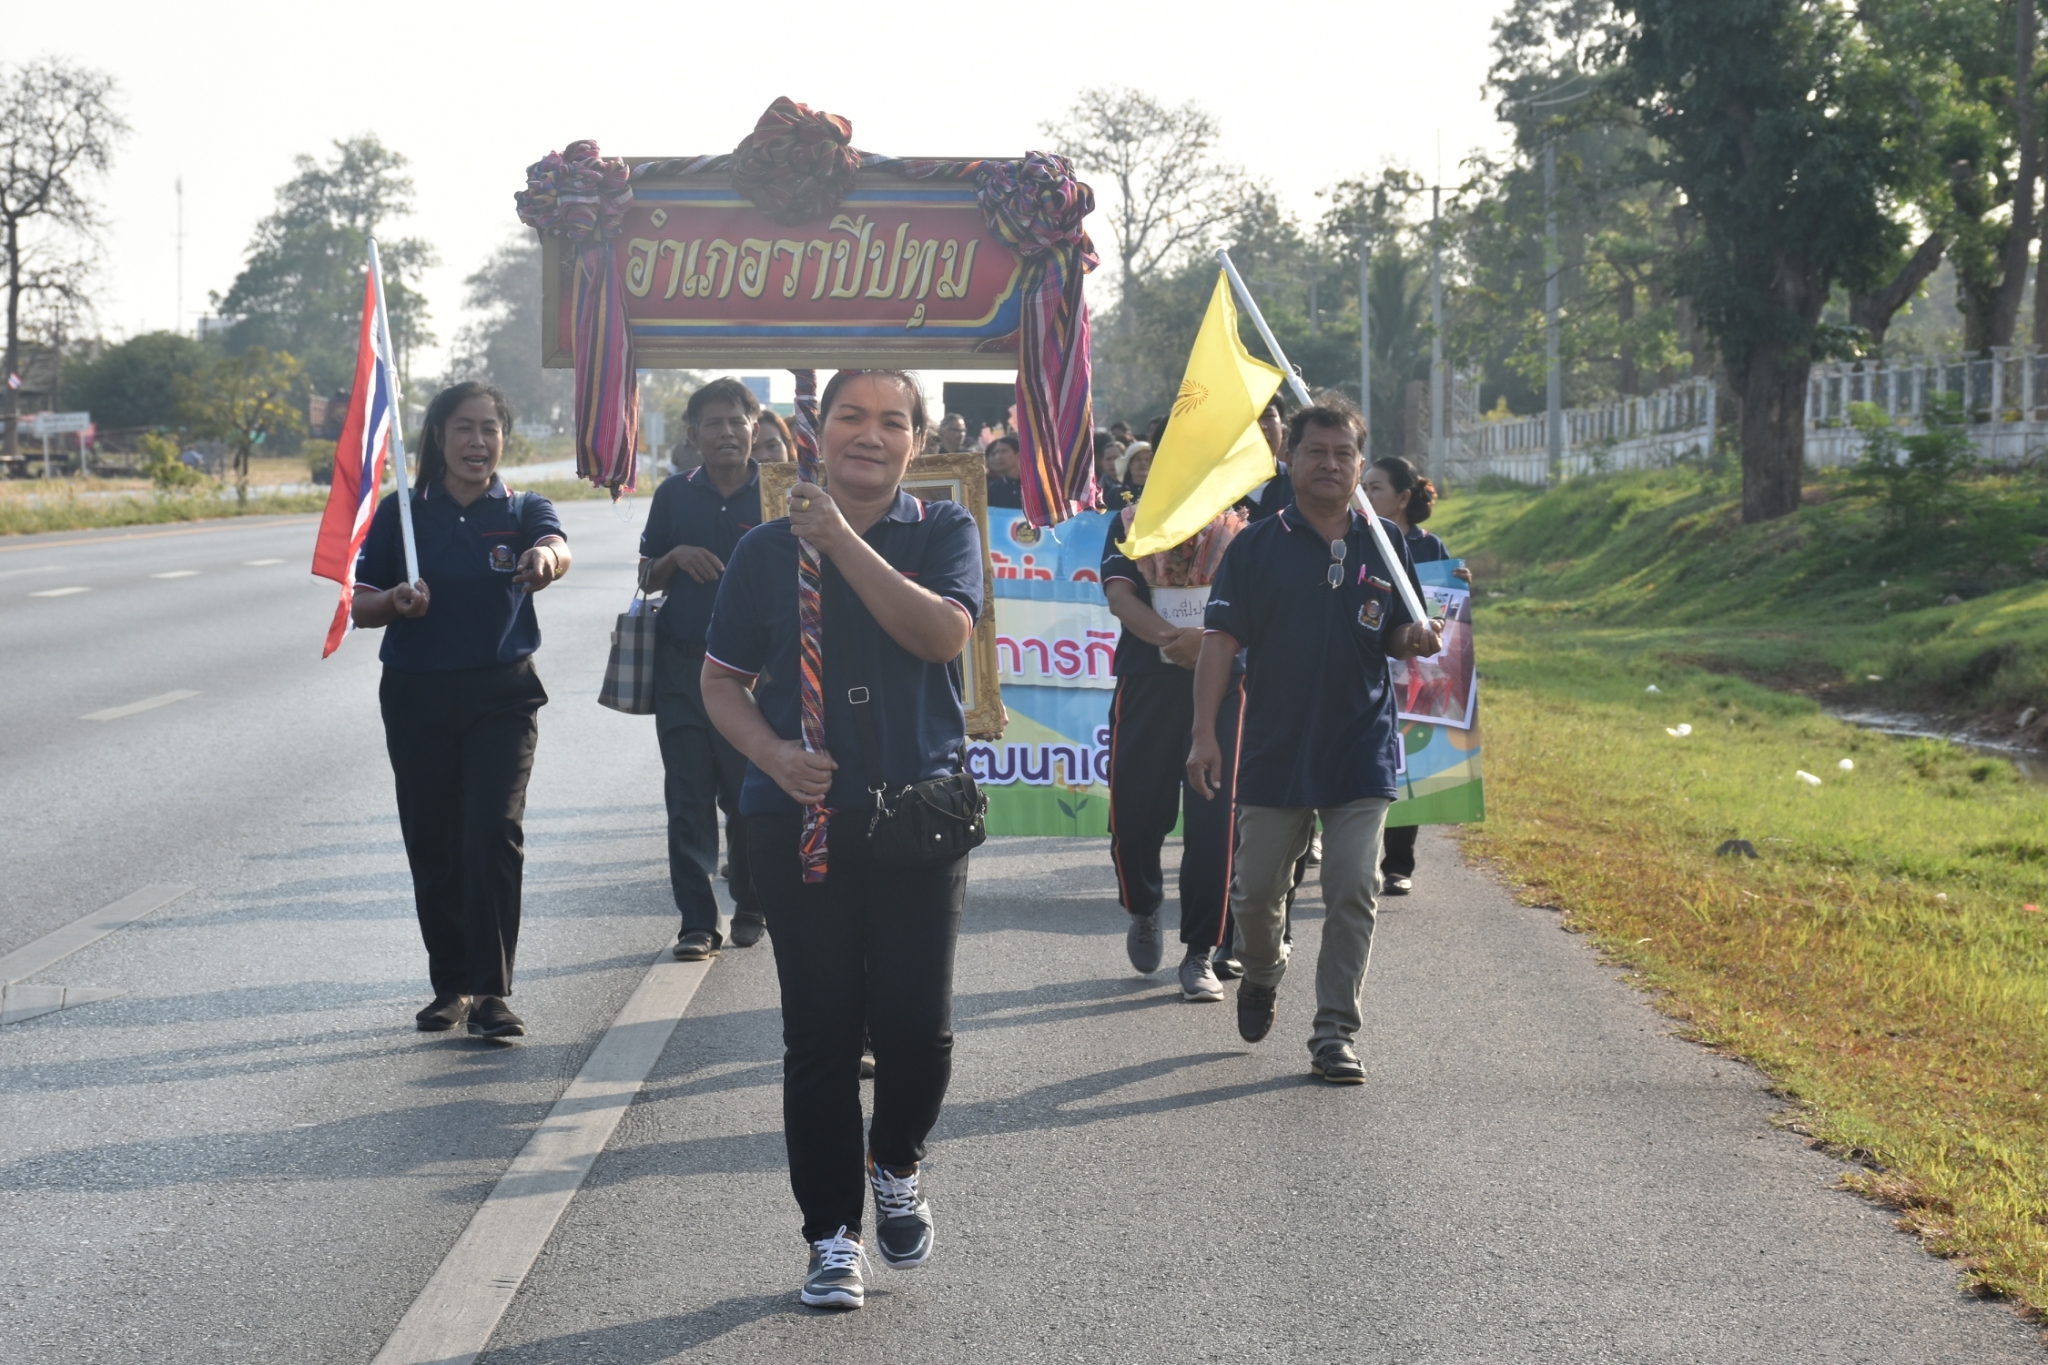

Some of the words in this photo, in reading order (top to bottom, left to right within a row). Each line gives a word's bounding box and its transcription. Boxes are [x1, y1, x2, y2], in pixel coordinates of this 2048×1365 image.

[624, 207, 980, 329] อำเภอวาปีปทุม
[1161, 598, 1206, 619] อ.วาปีป
